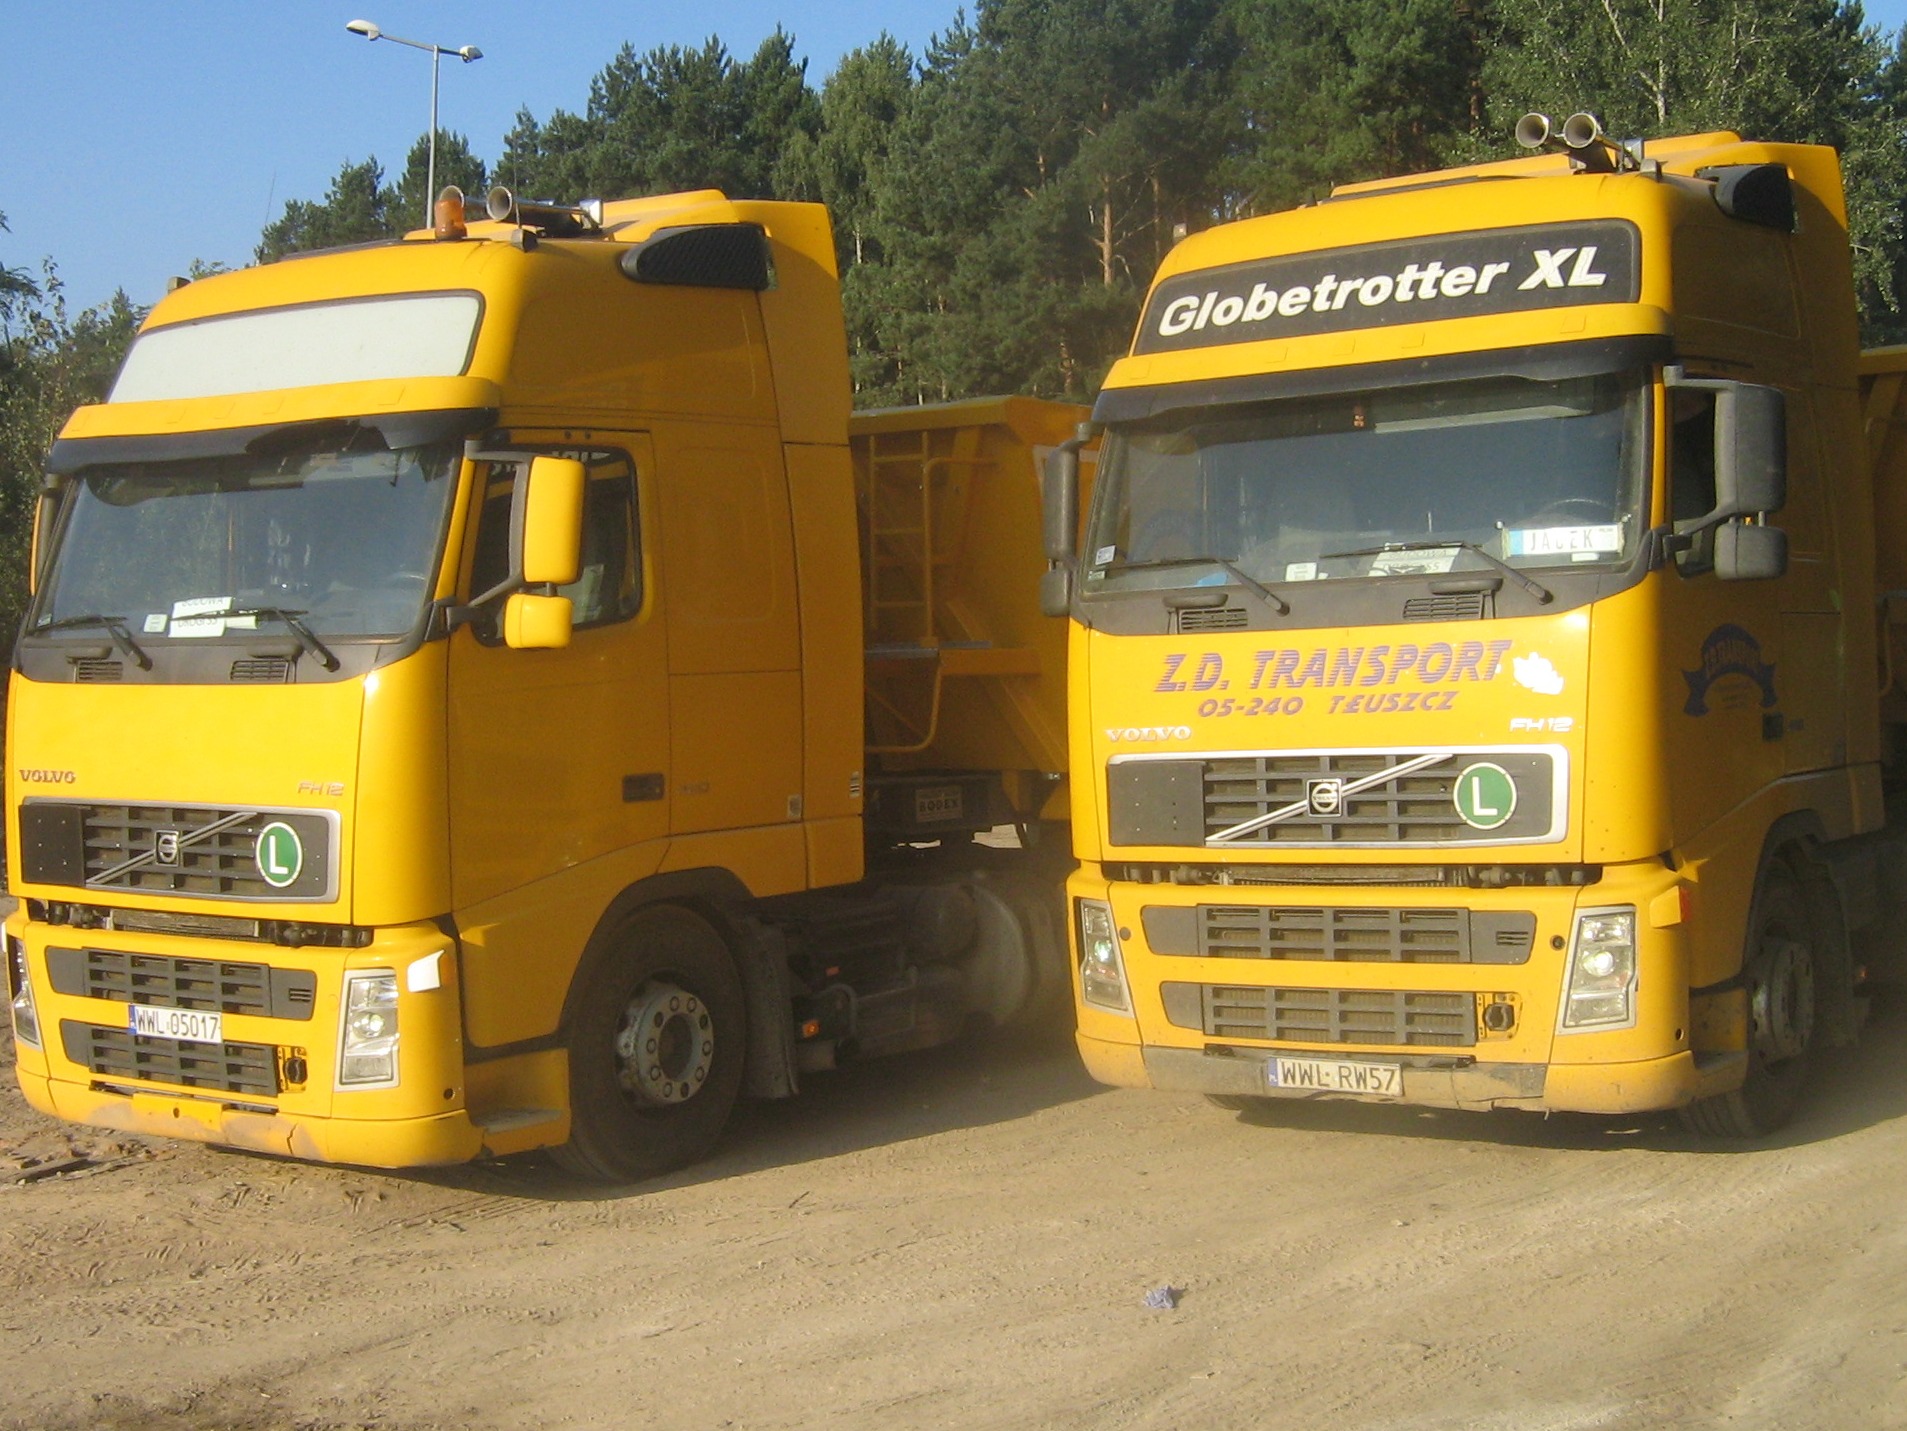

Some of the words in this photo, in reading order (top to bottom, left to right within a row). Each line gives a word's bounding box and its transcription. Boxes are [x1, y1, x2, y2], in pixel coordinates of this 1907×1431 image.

[1157, 260, 1510, 338] Globetrotter
[1517, 245, 1608, 292] XL
[1249, 639, 1513, 690] TRANSPORT
[1198, 696, 1304, 718] 05-240
[1104, 726, 1191, 742] VOLVO
[19, 769, 76, 784] VOLVO
[1471, 776, 1498, 816] L
[269, 835, 289, 875] L
[136, 1008, 164, 1034] WWL
[170, 1013, 218, 1040] 05017
[1281, 1061, 1330, 1087] WWL
[1337, 1065, 1395, 1091] RW57
